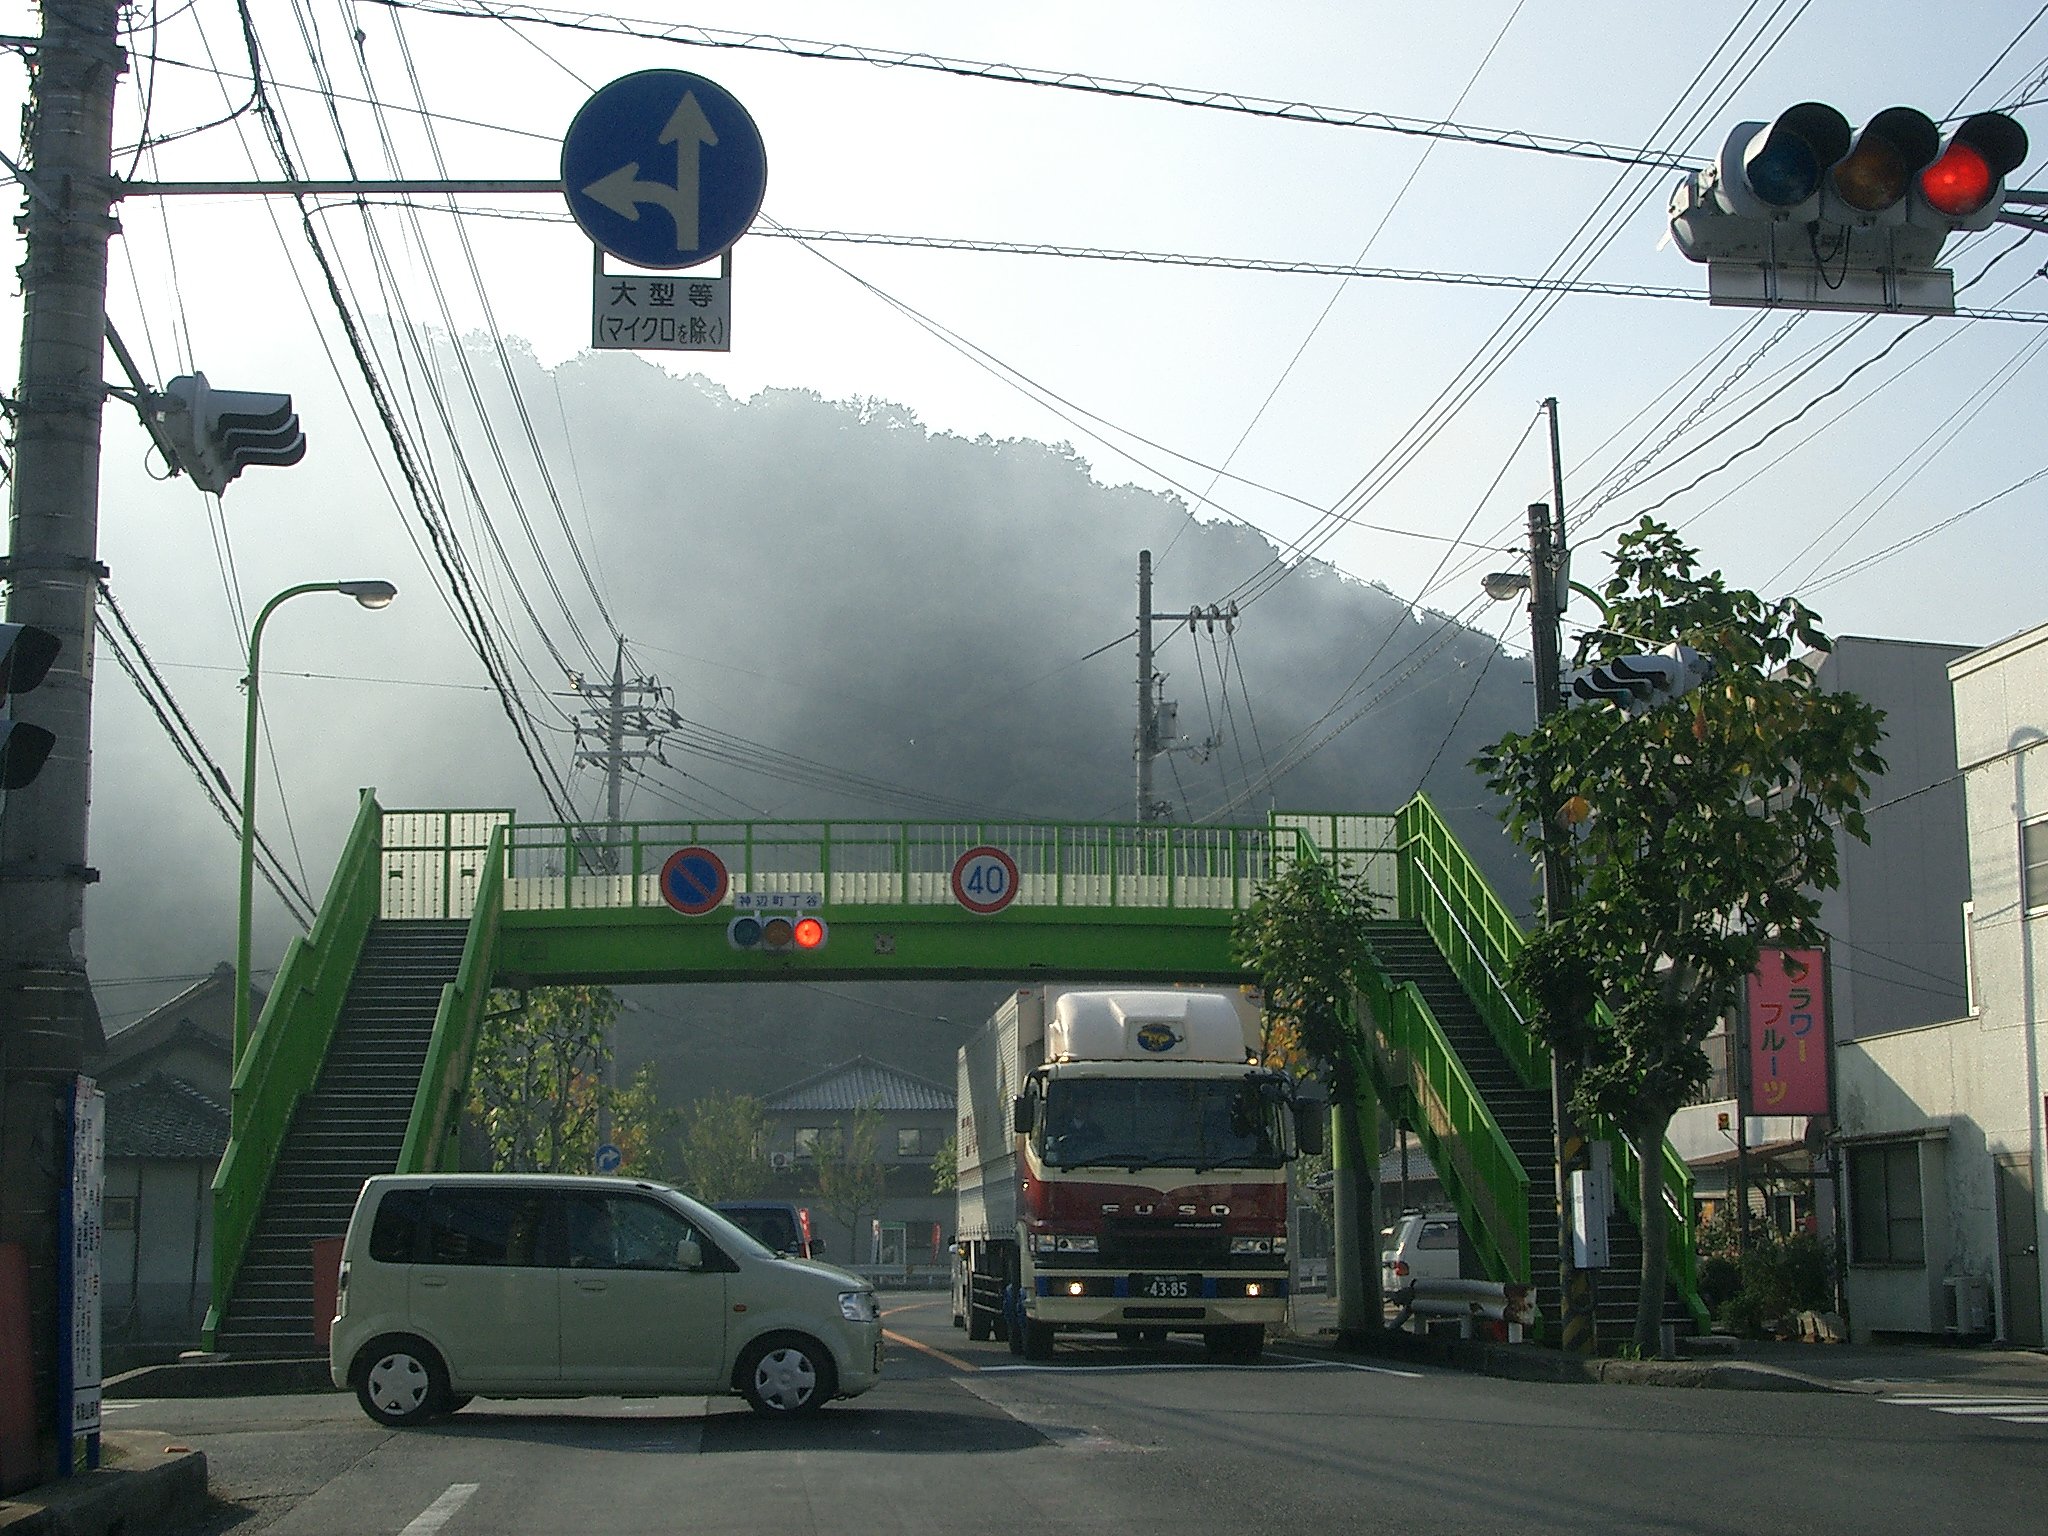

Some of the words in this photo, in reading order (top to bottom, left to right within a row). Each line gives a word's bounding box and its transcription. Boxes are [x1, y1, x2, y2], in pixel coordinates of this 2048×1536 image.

[611, 281, 713, 307] 大型等
[600, 315, 723, 345] (マイクロを除く)
[967, 865, 1004, 894] 40
[740, 895, 817, 907] 神辺町丁谷
[1760, 1002, 1787, 1105] フルーツ
[1101, 1203, 1232, 1216] FUSO
